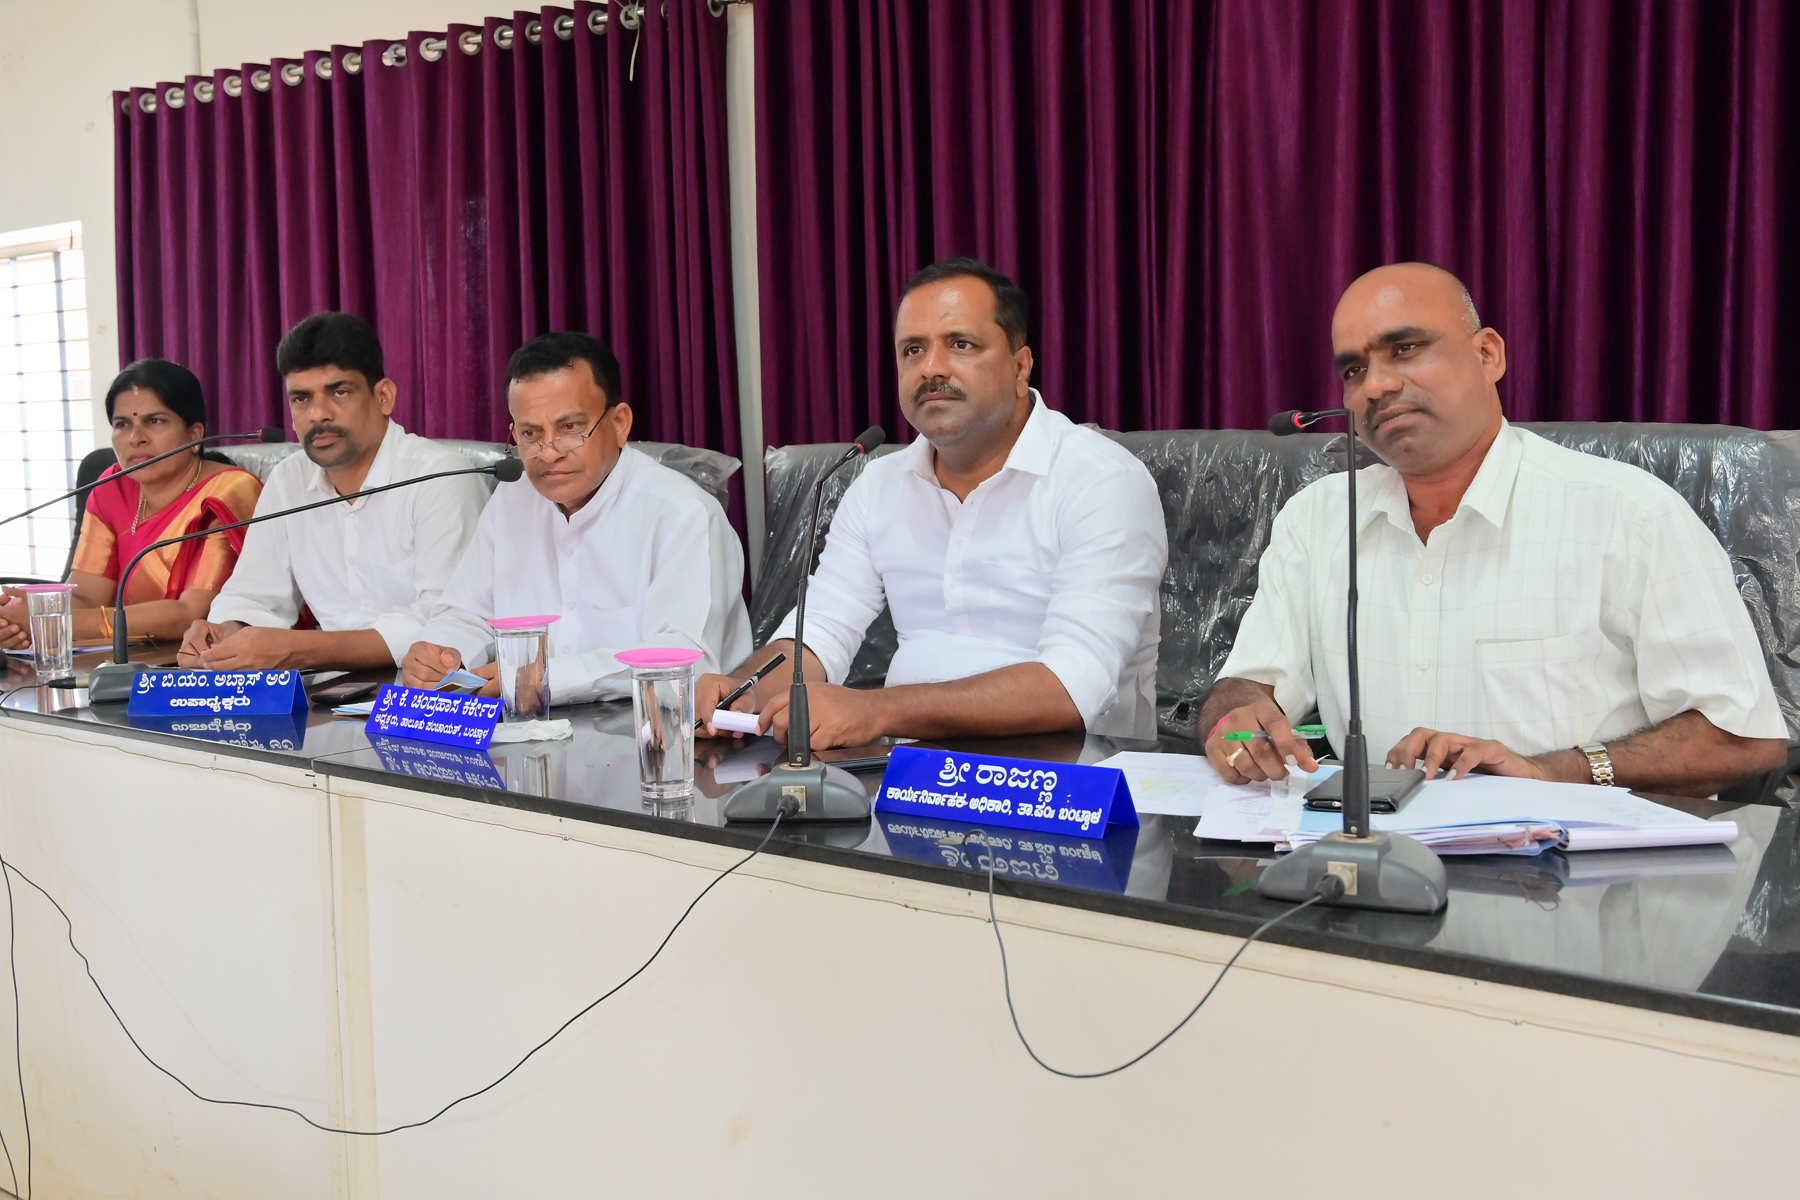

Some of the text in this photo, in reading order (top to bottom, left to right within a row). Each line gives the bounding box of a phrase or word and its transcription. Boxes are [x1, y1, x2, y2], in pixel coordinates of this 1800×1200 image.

[137, 672, 156, 694] ಶ್ರೀ
[214, 671, 263, 694] ಅಬ್ಬಾಸ್
[266, 670, 291, 686] ಅಲಿ
[170, 695, 251, 713] ಉಪಾಧ್ಯಕ್ಷರು
[379, 688, 397, 711] ಶ್ರೀ
[411, 692, 462, 717] ಚಂದ್ರಹಾಸ
[462, 697, 500, 719] ಕರ್ಕೇರ
[937, 757, 1058, 803] ಶ್ರೀ ರಾಜಣ್ಣ
[1059, 807, 1103, 831] ಬಂಟ್ವಾಳ
